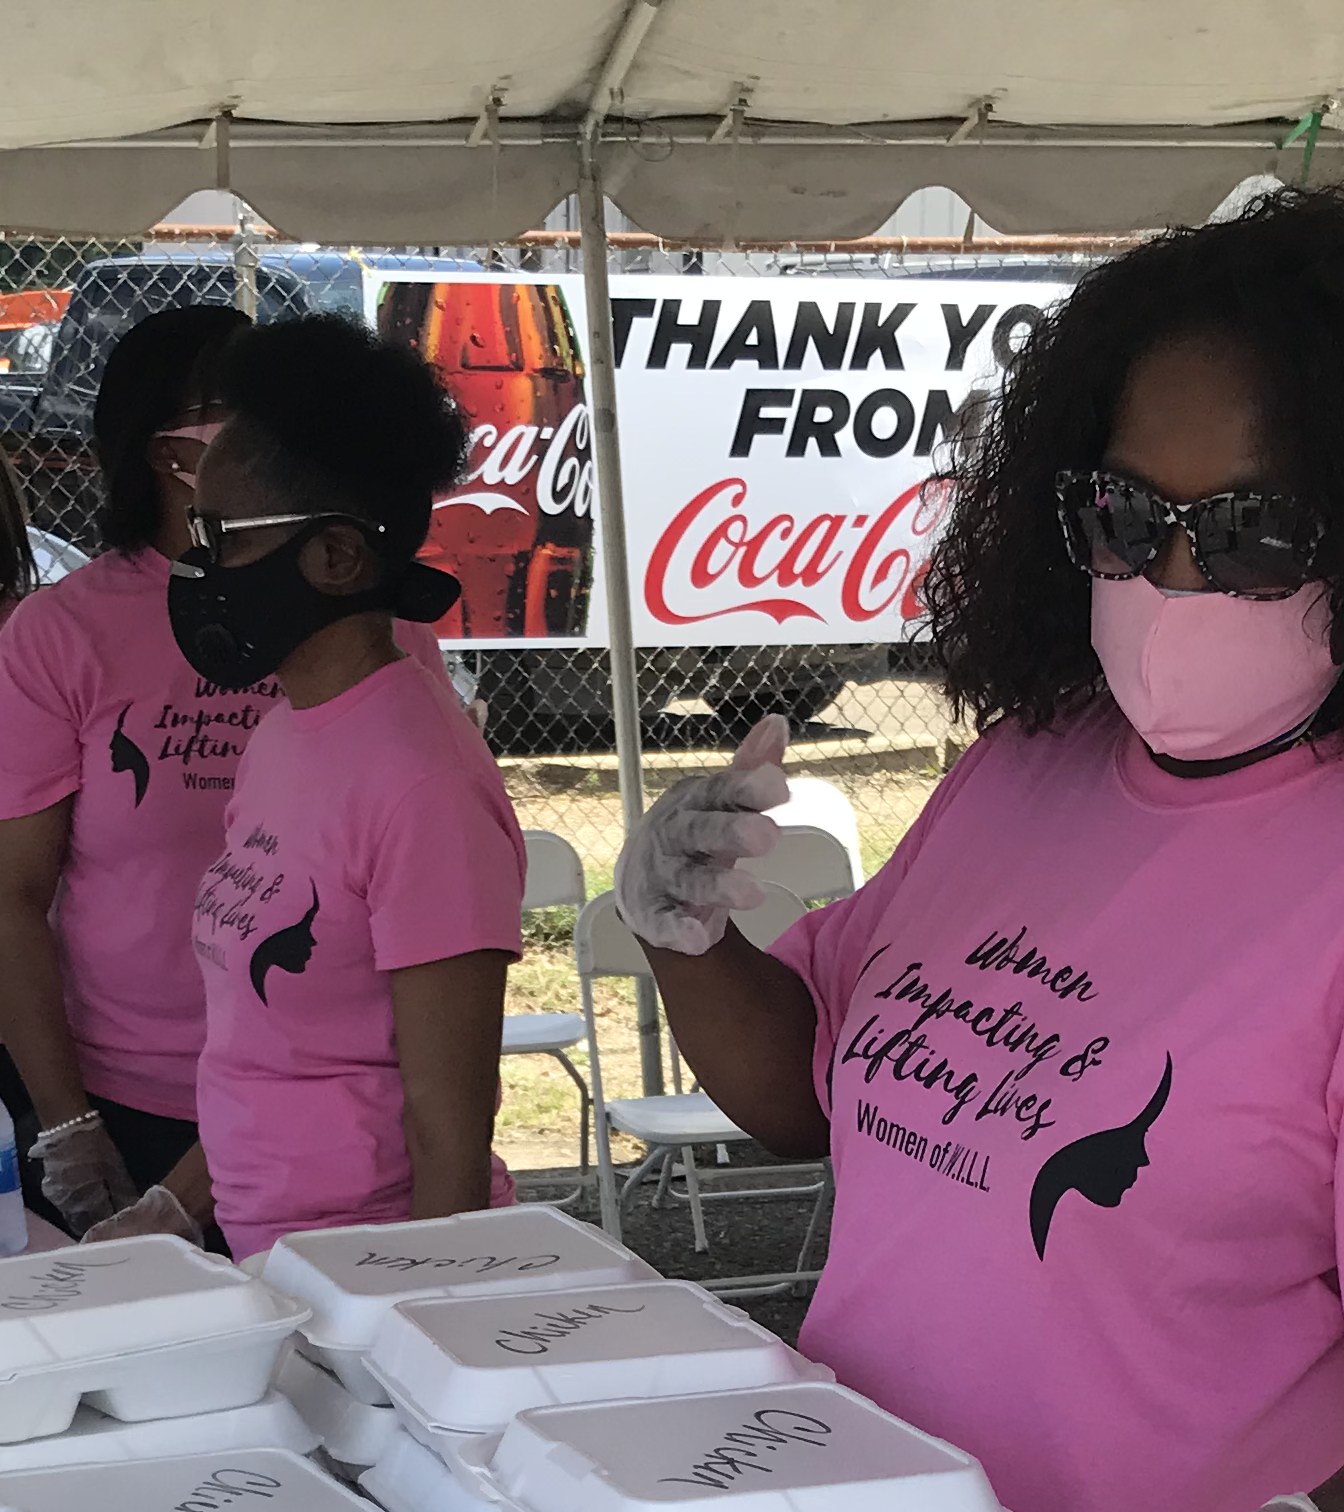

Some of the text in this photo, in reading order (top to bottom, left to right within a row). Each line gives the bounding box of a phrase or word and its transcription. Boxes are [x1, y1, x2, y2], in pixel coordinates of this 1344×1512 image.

[609, 297, 1048, 371] THANK YO
[728, 389, 993, 458] FROM
[154, 704, 261, 737] Impacti
[158, 735, 246, 766] Liftin
[259, 873, 285, 904] &
[964, 926, 1099, 1002] Women
[874, 962, 1110, 1083] Impacting &
[841, 1014, 1056, 1142] Lifting Lives
[857, 1099, 929, 1163] Women
[929, 1141, 953, 1171] of
